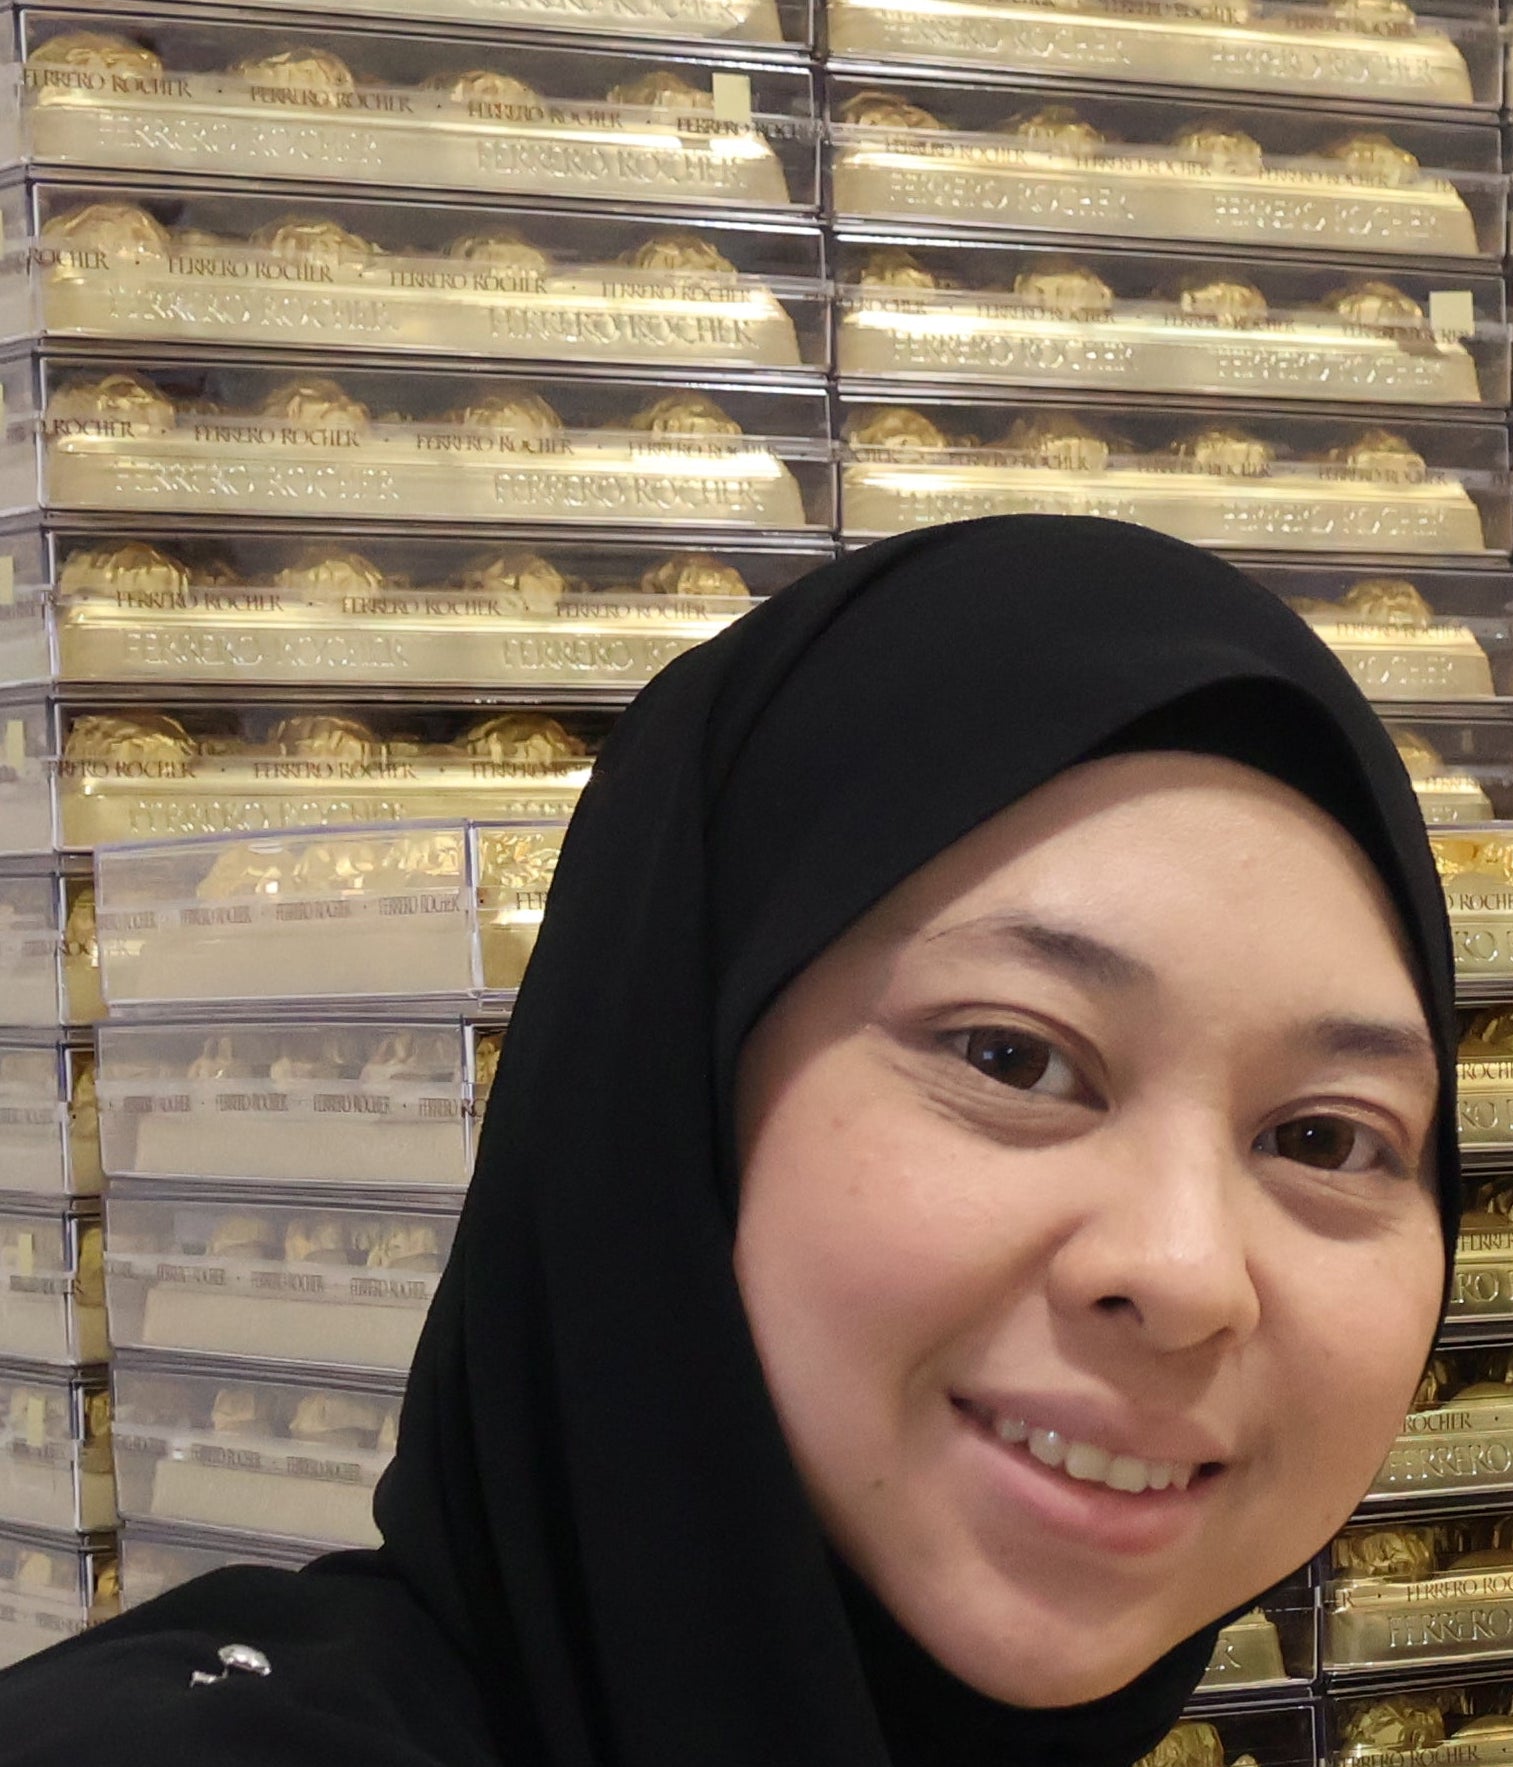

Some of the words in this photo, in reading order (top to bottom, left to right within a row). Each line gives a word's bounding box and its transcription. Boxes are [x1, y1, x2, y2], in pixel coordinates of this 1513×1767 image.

[112, 74, 192, 98] ROCHER
[336, 91, 413, 113] ROCHER
[169, 258, 248, 277] FERRERO
[256, 262, 334, 283] ROCHER
[390, 271, 466, 290] FERRERO
[474, 277, 547, 294] ROCHER
[195, 425, 274, 445] FERRERO
[282, 429, 360, 447] ROCHER
[117, 591, 198, 610] FERRERO
[205, 591, 283, 611] ROCHER
[342, 596, 419, 614] FERRERO
[426, 600, 502, 617] ROCHER
[1403, 1412, 1472, 1433] ROCHER
[1407, 1579, 1477, 1601] FERRERO
[1388, 1606, 1511, 1648] FERRERO
